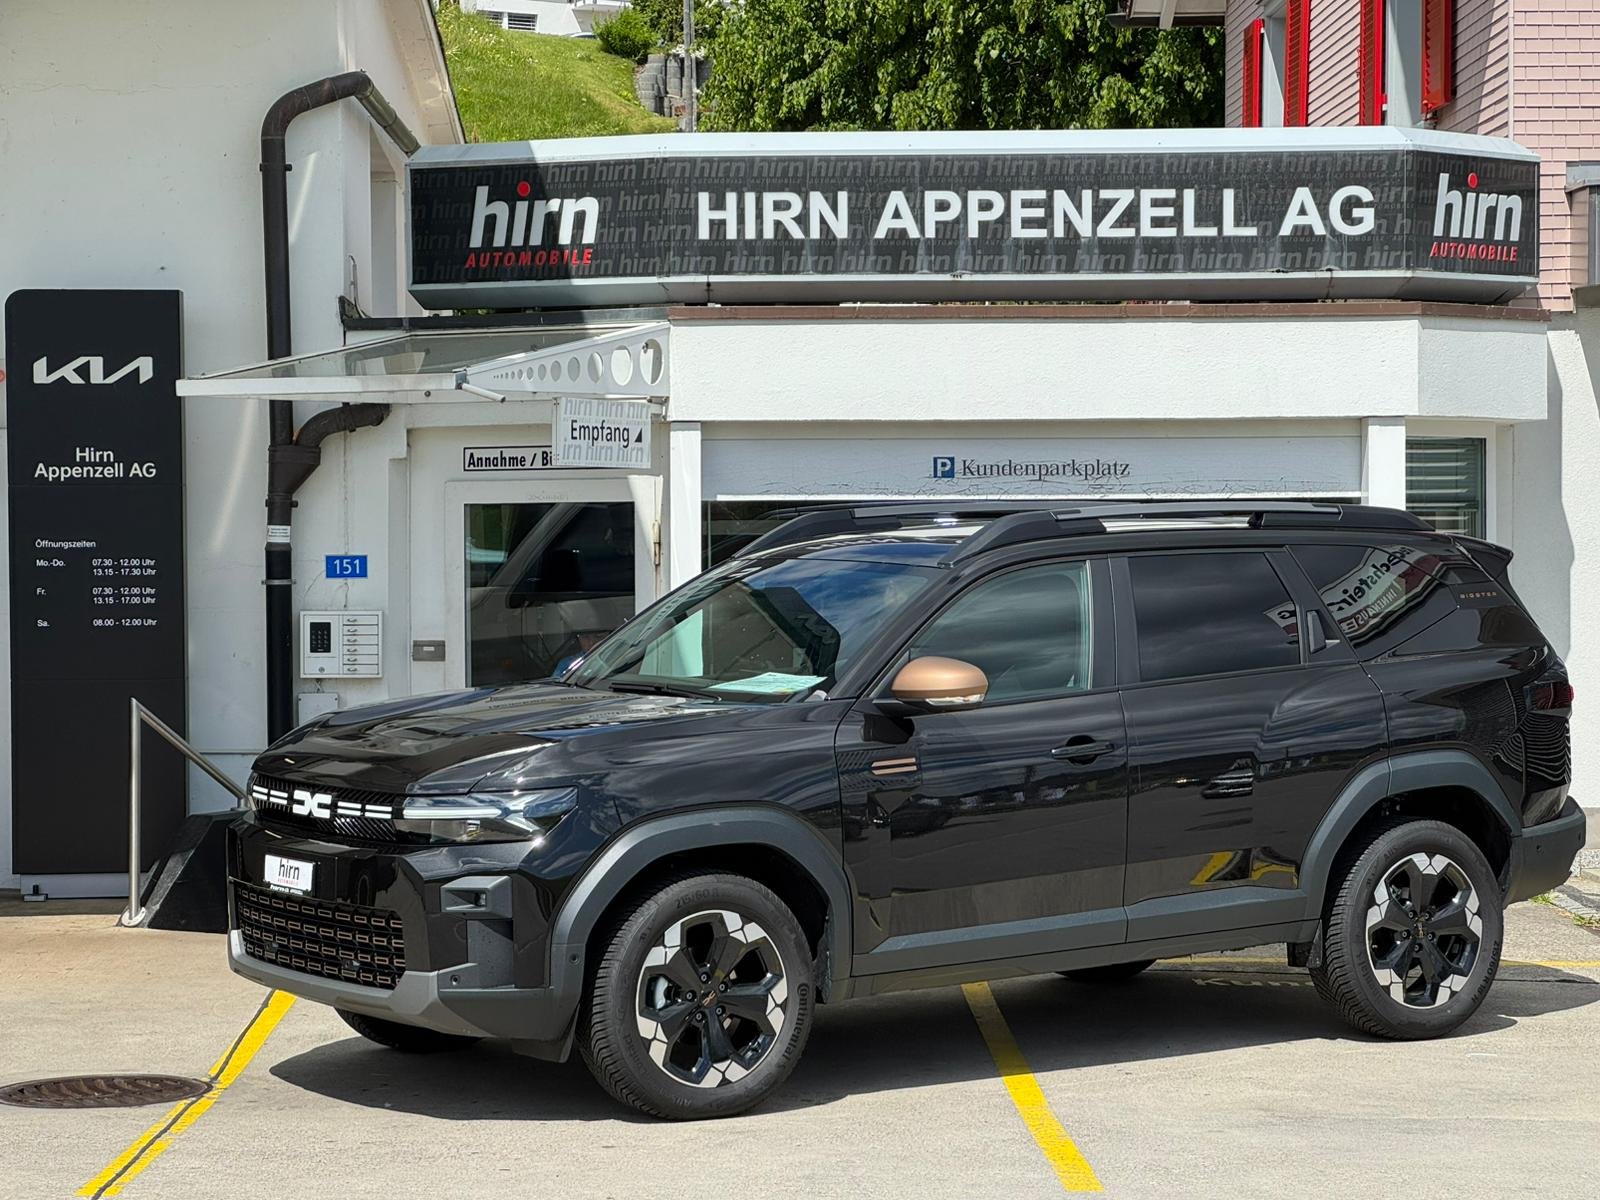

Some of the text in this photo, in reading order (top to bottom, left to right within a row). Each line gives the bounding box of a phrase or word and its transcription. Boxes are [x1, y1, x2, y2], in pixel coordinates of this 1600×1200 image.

[469, 181, 599, 248] hirn
[698, 191, 848, 239] HIRN
[874, 188, 1257, 239] APPENZELL
[1278, 185, 1375, 236] AG
[1433, 172, 1522, 241] hirn
[466, 248, 593, 268] AUTOMOBILE
[1429, 241, 1518, 262] AUTOMOBILE
[33, 356, 154, 384] KIA
[571, 420, 630, 449] Empfang
[76, 447, 114, 462] Hirn
[468, 451, 527, 468] Annahme
[530, 453, 537, 467] /
[34, 463, 156, 480] Appenzell AG
[962, 459, 1130, 480] Kundenparkplatz
[35, 539, 96, 549] Öffnungszeiten
[36, 559, 66, 567] Mo.-Do.
[93, 568, 113, 576] 13.15
[121, 568, 141, 576] 17.30
[142, 568, 156, 576] Uhr
[333, 559, 360, 574] 151
[92, 587, 113, 595] 07.30
[120, 587, 140, 595] 12.00
[142, 587, 156, 595] Uhr
[92, 619, 114, 627] 08.00
[121, 619, 142, 627] 12.00
[143, 619, 157, 627] Uhr
[279, 858, 300, 880] hirn
